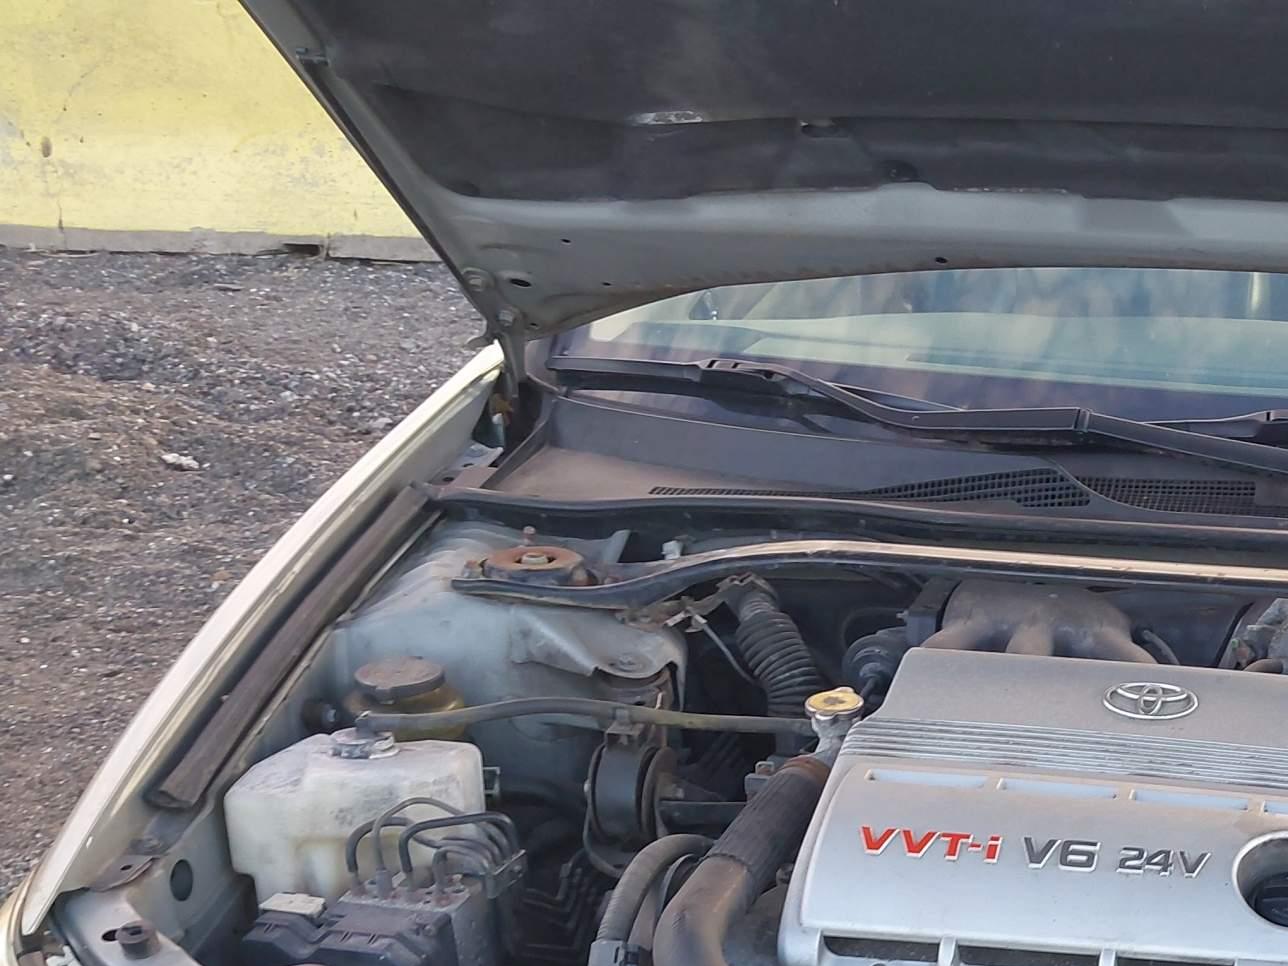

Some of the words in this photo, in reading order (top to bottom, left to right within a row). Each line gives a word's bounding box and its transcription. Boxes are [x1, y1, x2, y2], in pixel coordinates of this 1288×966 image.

[860, 825, 1003, 864] VVT-i
[1023, 836, 1102, 873] V6
[1115, 846, 1212, 879] 24V
